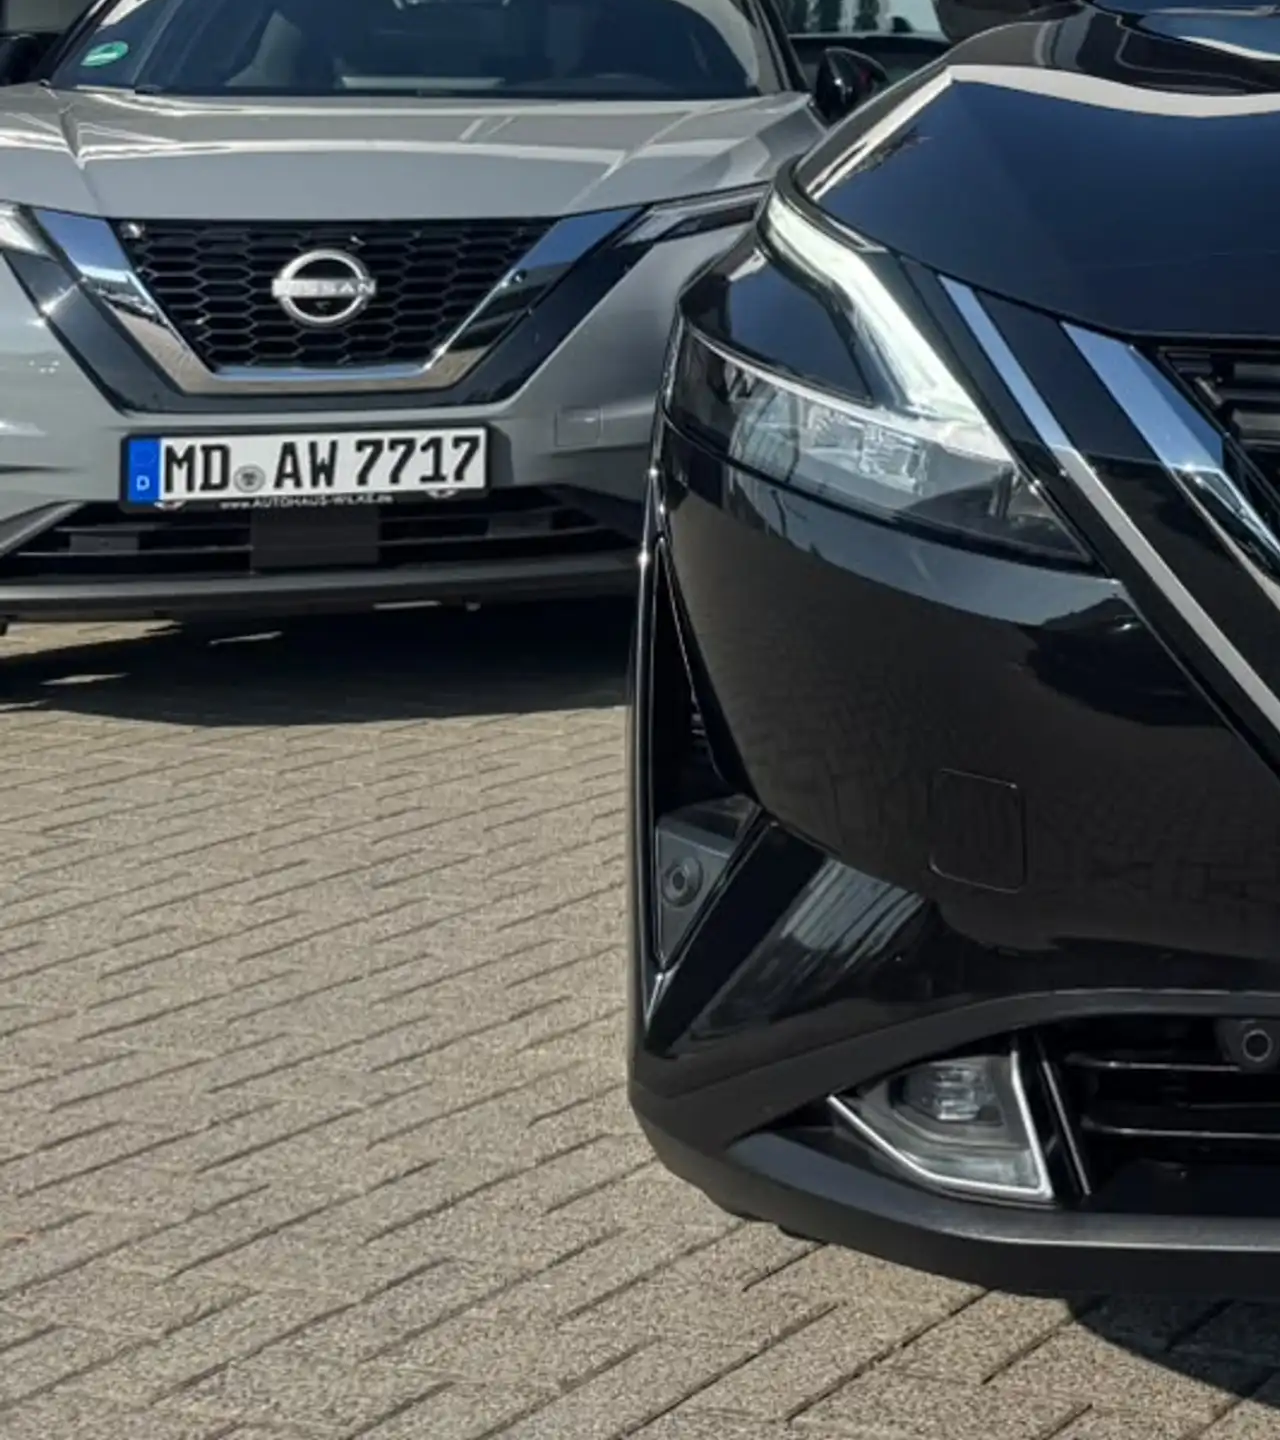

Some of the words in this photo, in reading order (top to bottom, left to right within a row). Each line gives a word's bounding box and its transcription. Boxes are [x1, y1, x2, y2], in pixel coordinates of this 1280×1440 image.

[164, 444, 231, 493] MD
[274, 440, 338, 489] AW
[355, 435, 481, 486] 7717
[136, 475, 150, 491] D
